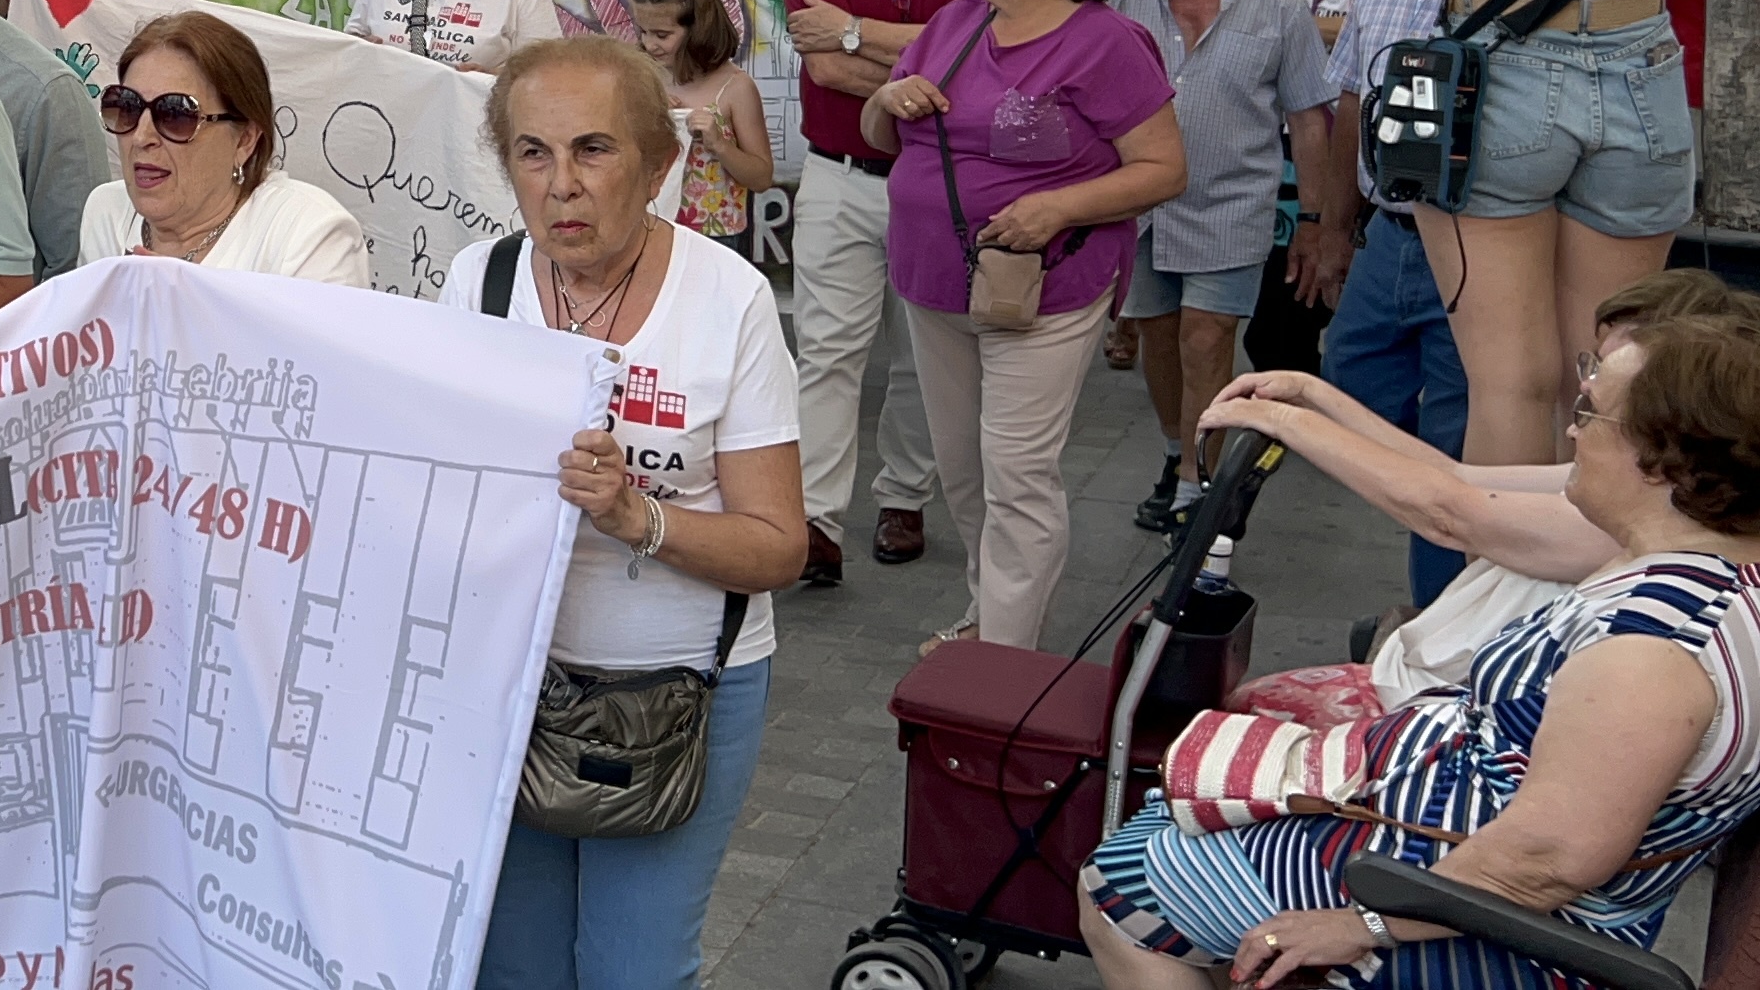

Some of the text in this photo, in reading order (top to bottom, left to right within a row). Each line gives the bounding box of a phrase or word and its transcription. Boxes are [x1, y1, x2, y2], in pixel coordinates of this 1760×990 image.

[383, 10, 447, 28] SANAD
[389, 34, 405, 44] NO
[322, 100, 506, 238] Querem
[257, 497, 312, 564] H)
[114, 760, 259, 865] URGENCIAS
[195, 871, 344, 990] Consultas
[15, 950, 43, 990] y
